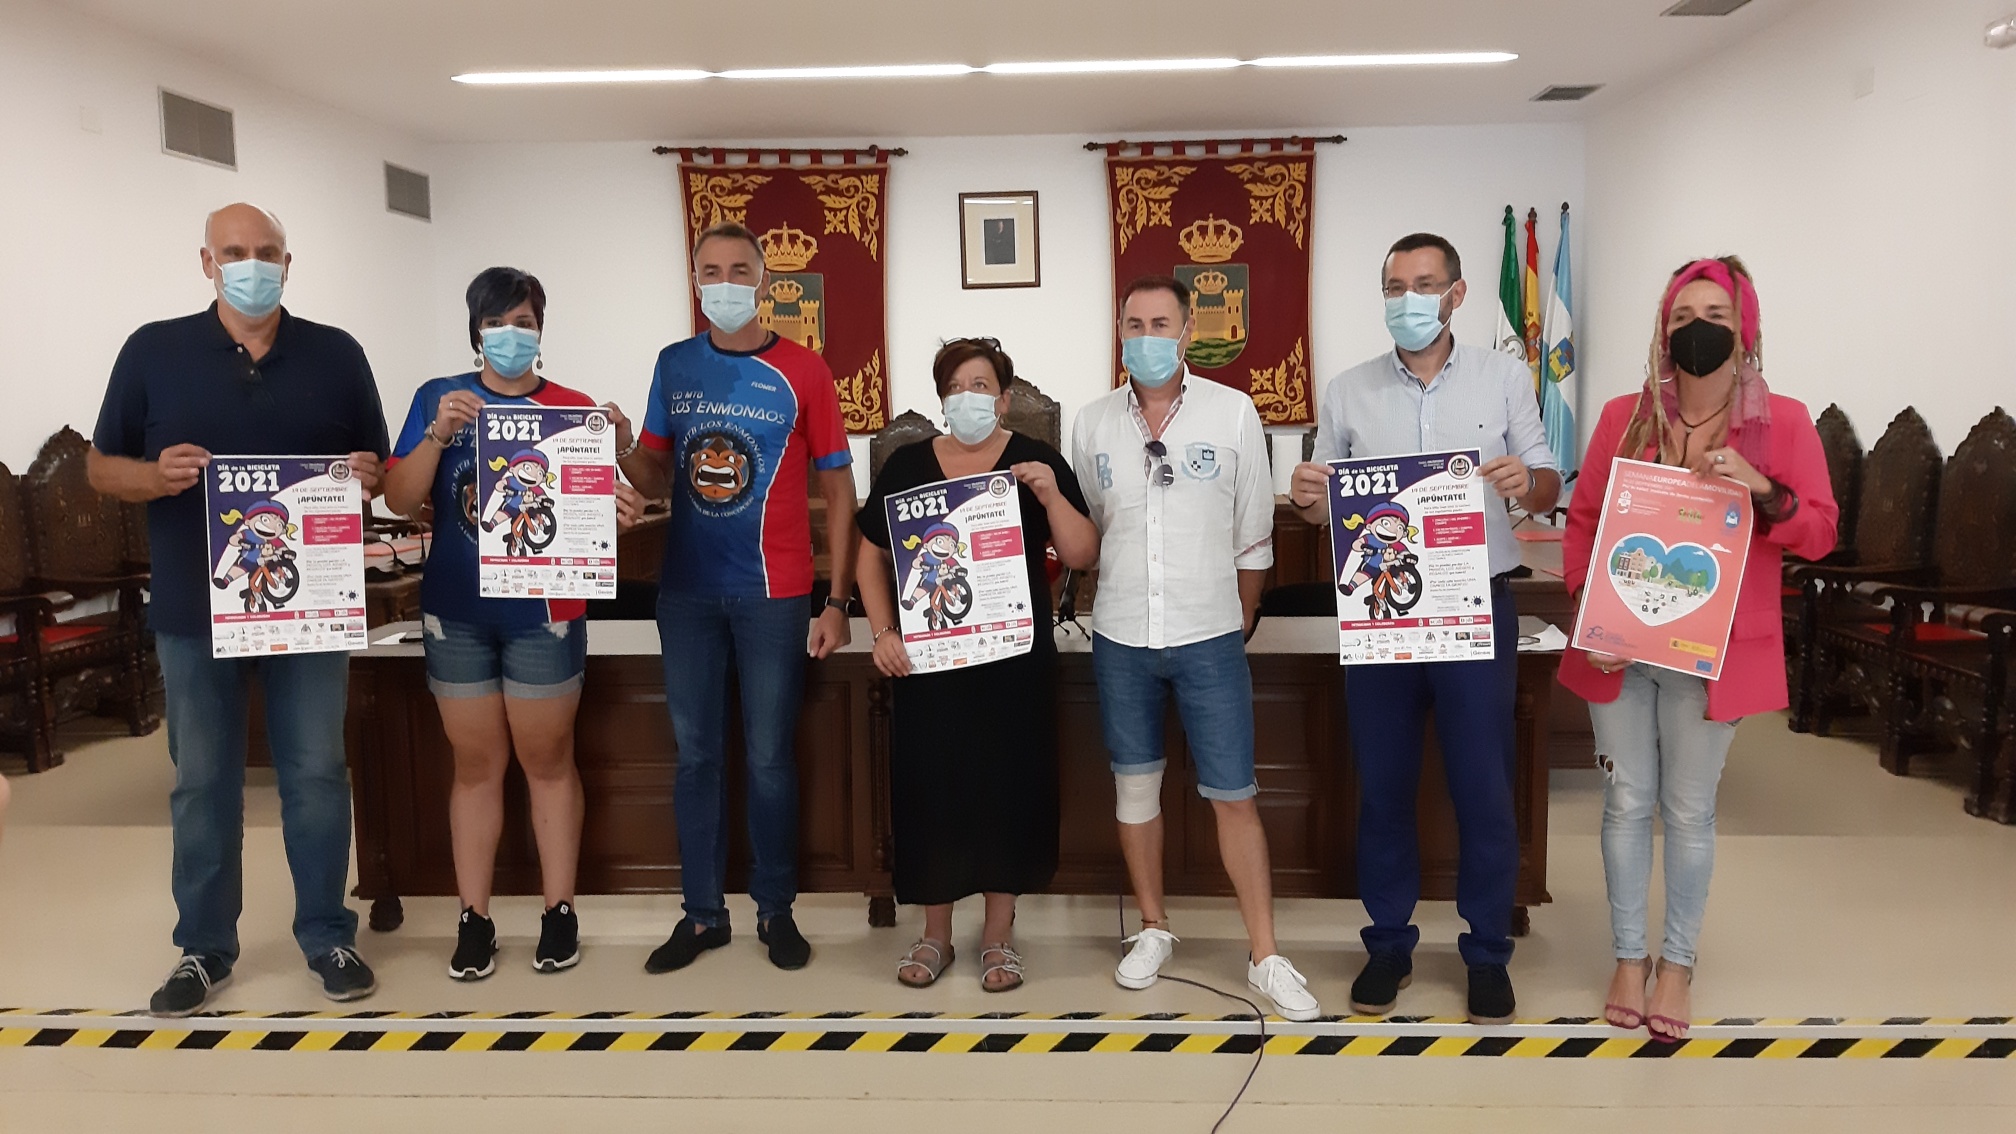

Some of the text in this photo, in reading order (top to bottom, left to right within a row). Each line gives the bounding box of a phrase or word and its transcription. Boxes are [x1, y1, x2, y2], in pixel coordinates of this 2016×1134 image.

[671, 401, 787, 425] LOS ENMONAOS
[487, 420, 542, 441] 2021
[700, 420, 722, 430] LOS
[1366, 464, 1399, 473] BICICLETA
[218, 471, 280, 492] 2021
[1340, 472, 1399, 497] 2021
[297, 495, 345, 504] ¡APÚNTATE!
[897, 495, 950, 522] 2021
[1417, 492, 1466, 505] ¡APÚNTATE!
